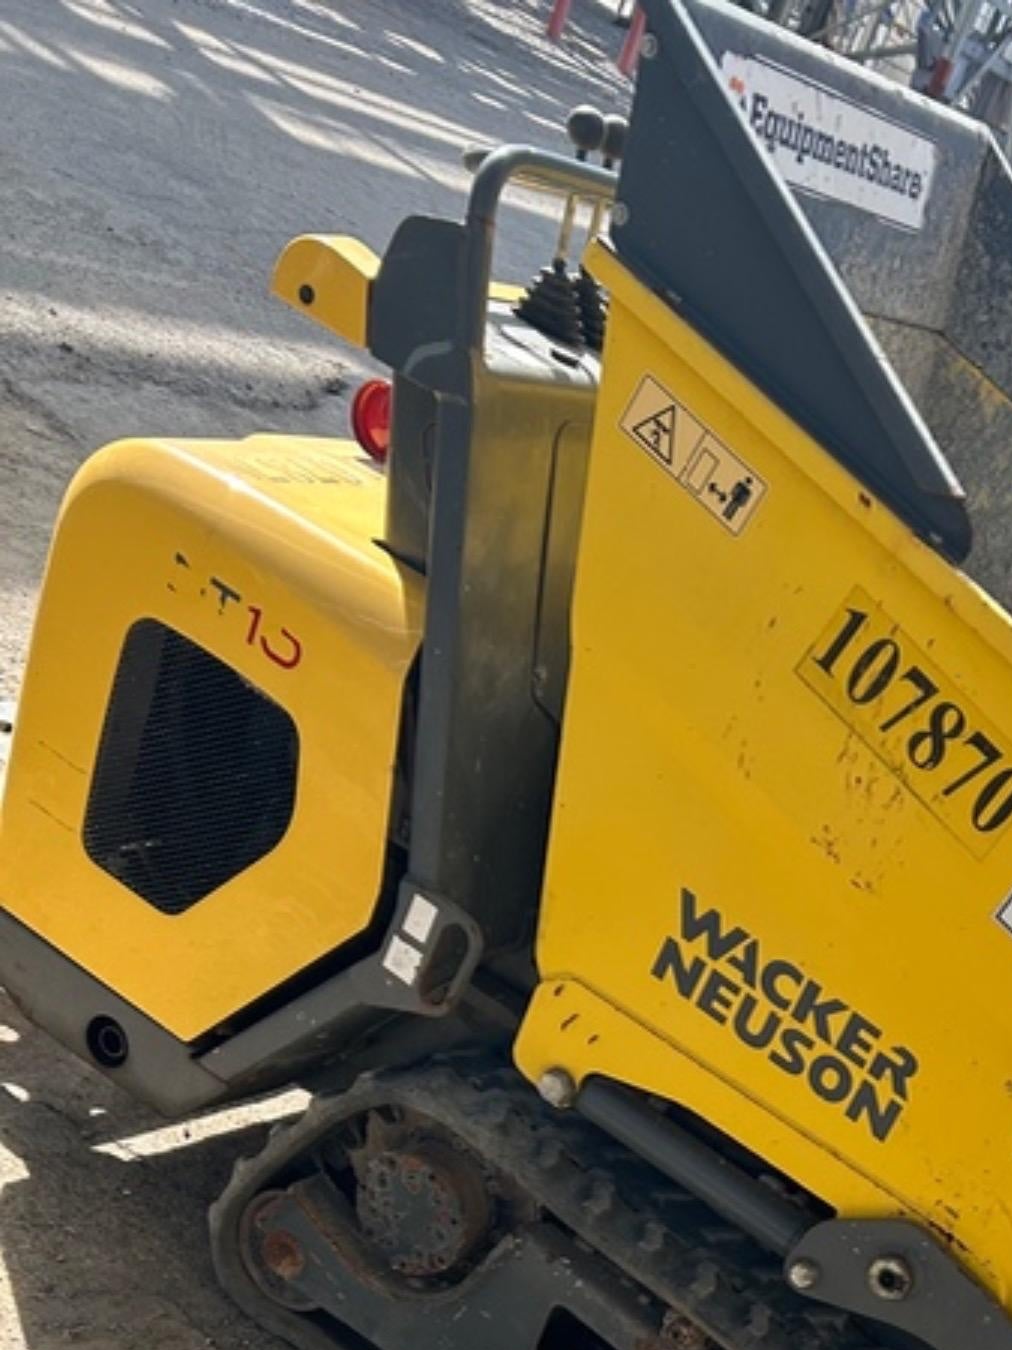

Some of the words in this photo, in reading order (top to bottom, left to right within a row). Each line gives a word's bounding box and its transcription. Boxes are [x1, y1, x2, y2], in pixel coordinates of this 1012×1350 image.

[750, 92, 923, 199] EquipmentShare
[651, 937, 904, 1142] NEUSON
[680, 887, 919, 1103] WACKER
